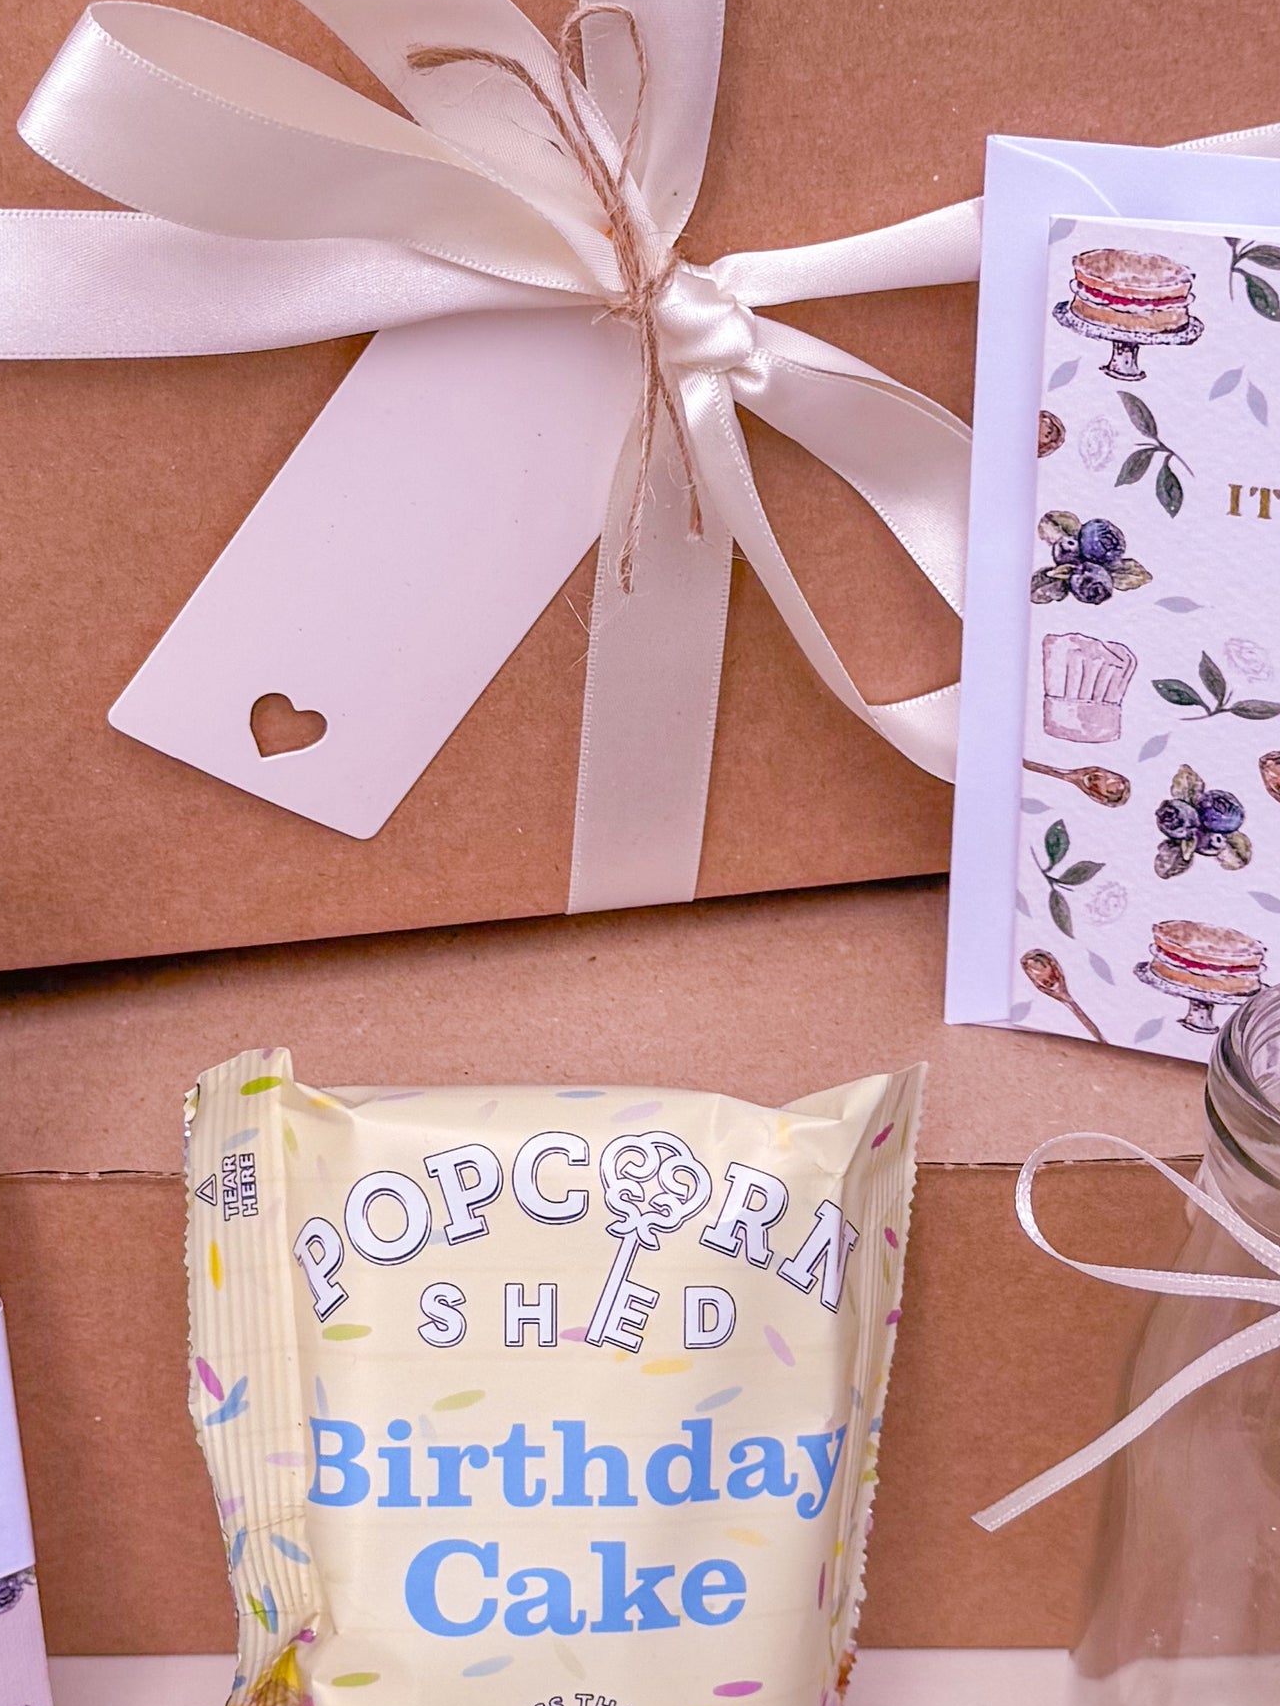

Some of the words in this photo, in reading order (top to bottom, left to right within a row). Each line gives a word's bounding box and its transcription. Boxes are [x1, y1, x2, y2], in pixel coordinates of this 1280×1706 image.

[222, 1154, 240, 1222] TEAR
[239, 1152, 259, 1217] HERE
[293, 1131, 860, 1323] POPCORN
[418, 1281, 737, 1354] SHED
[307, 1415, 849, 1521] Birthday
[404, 1537, 748, 1638] Cake
